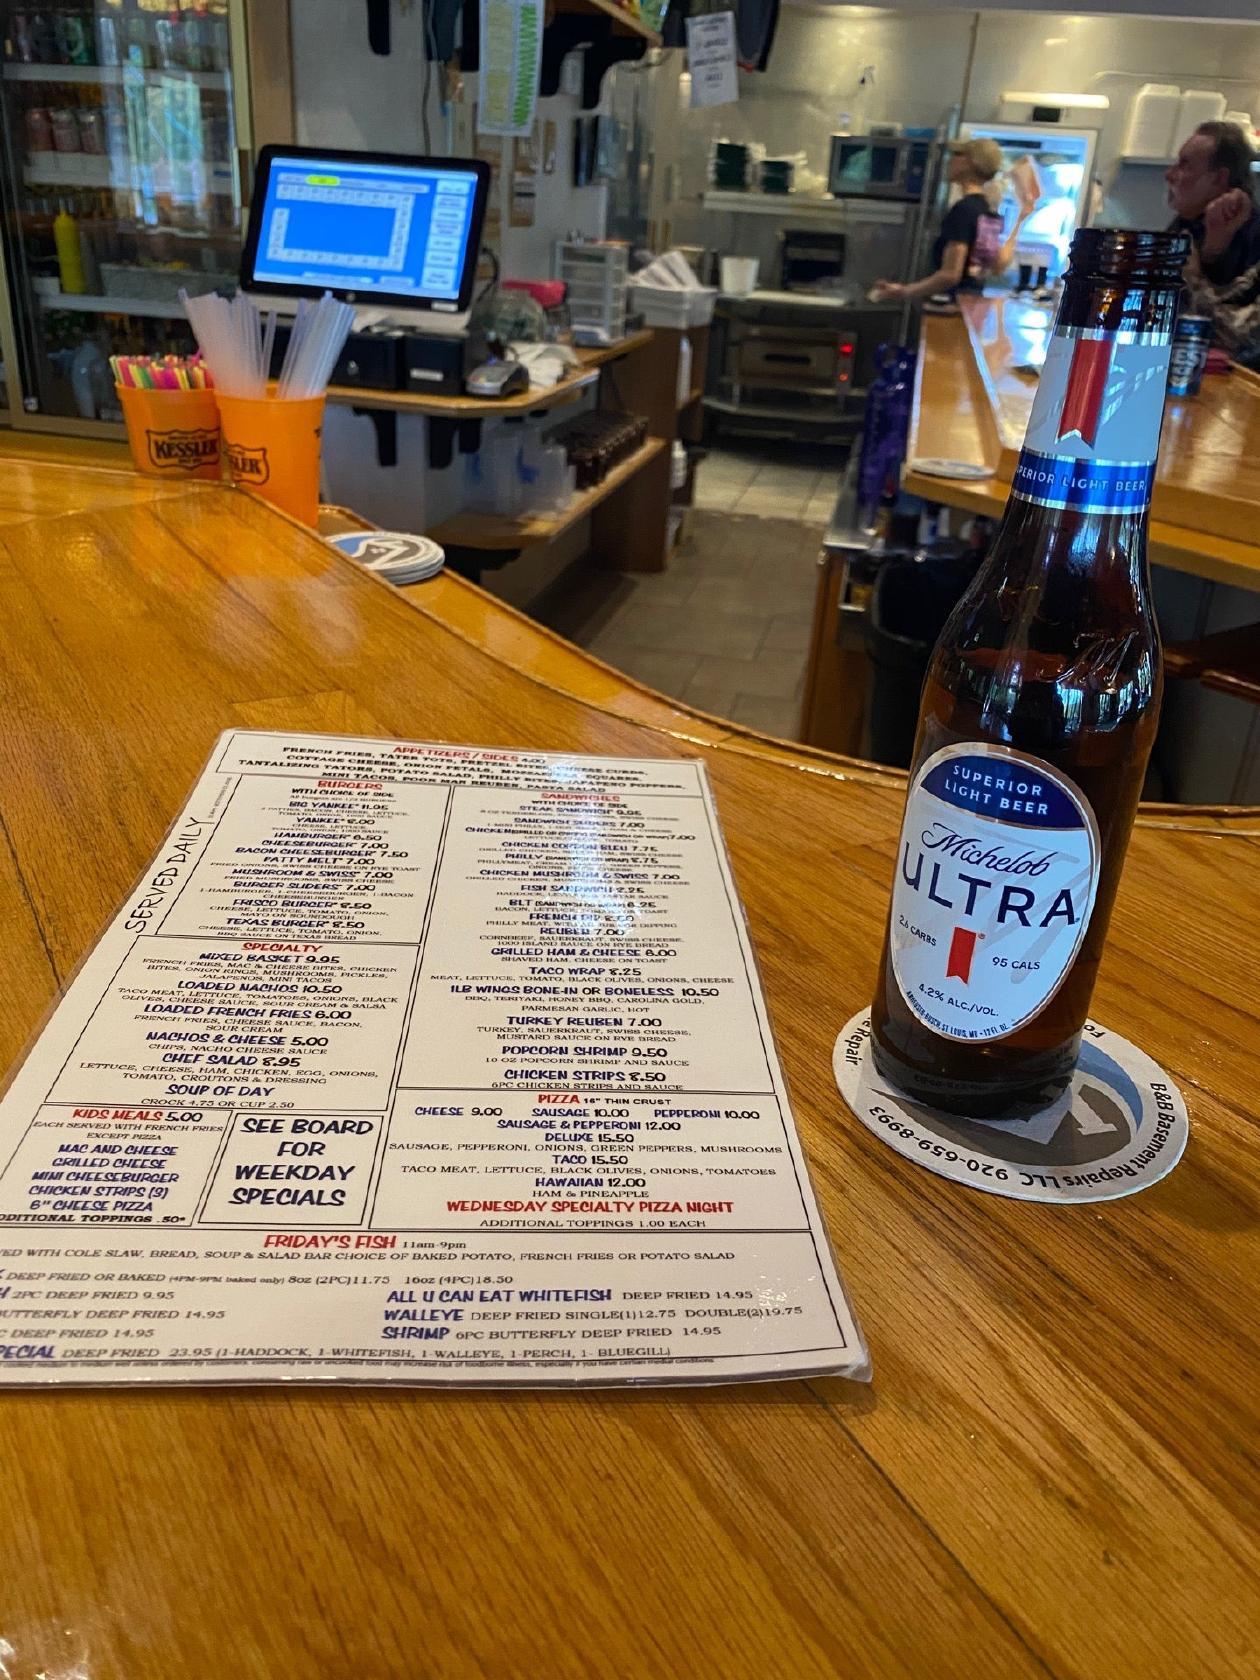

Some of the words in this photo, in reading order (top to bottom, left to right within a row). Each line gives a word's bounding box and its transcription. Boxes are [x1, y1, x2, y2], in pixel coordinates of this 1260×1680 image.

[1063, 477, 1108, 490] LIGHT
[1115, 480, 1145, 491] BEER
[953, 764, 1043, 797] SUPERIOR
[945, 779, 992, 806] LIGHT
[1000, 797, 1049, 816] BEER
[921, 822, 1058, 877] Michelob
[125, 867, 178, 934] SERVED
[166, 816, 215, 864] DAILY
[903, 841, 1078, 928] ULTRA
[226, 918, 269, 926] TEXAS
[910, 926, 937, 947] CARBS
[243, 941, 323, 953] SPECIALTY
[547, 948, 576, 956] HAM
[199, 953, 243, 961] MIXED
[246, 954, 304, 963] BASKET
[304, 956, 340, 964] 9.95
[992, 956, 1008, 968] 95
[1011, 960, 1041, 970] CALS
[528, 967, 564, 975] TACO
[568, 967, 605, 975] WRAP
[608, 968, 641, 976] 8.25
[178, 981, 235, 991] LOADED
[237, 983, 299, 993] NACHOS
[302, 985, 343, 994] 10.50
[476, 986, 520, 994] WINGS
[523, 986, 578, 995] BONE-IN
[582, 987, 601, 995] OR
[605, 987, 675, 996] BONELESS
[681, 988, 719, 996] 10.50
[918, 983, 944, 1002] 4.2%
[947, 997, 999, 1017] ALC./VOL.
[144, 1004, 204, 1014] LOADED
[207, 1006, 267, 1017] FRENCH
[269, 1009, 312, 1019] FRIES
[314, 1010, 352, 1019] 6.00
[506, 1016, 564, 1025] TURKEY
[567, 1017, 623, 1026] REUBEN
[627, 1018, 662, 1027] 7.00
[145, 1032, 210, 1042] NACHOS
[212, 1034, 225, 1043] &
[227, 1034, 287, 1045] CHEESE
[290, 1037, 329, 1046] 5.00
[502, 1046, 568, 1055] POPCORN
[573, 1047, 627, 1056] SHRIMP
[631, 1048, 668, 1058] 9.50
[845, 1028, 871, 1066] Repair
[162, 1053, 205, 1064] CHEF
[205, 1055, 258, 1066] SALAD
[262, 1057, 302, 1067] 8.95
[504, 1069, 567, 1080] CHICKEN
[572, 1070, 626, 1081] STRIPS
[628, 1072, 666, 1082] 8.50
[165, 1084, 210, 1095] SOUP
[213, 1086, 236, 1096] OF
[238, 1086, 276, 1096] DAY
[1150, 1082, 1174, 1111] B&B
[141, 1098, 185, 1106] CROCK
[538, 1094, 581, 1104] PIZZA
[633, 1098, 672, 1106] CRUST
[72, 1109, 110, 1119] KIDS
[111, 1110, 164, 1121] MEALS
[164, 1112, 203, 1122] 5.00
[415, 1107, 464, 1116] CHEESE
[471, 1107, 503, 1116] 9.00
[531, 1108, 590, 1117] SAUSAGE
[594, 1109, 629, 1117] 10.00
[654, 1109, 721, 1118] PEPPERONI
[724, 1110, 760, 1119] 10.00
[240, 1118, 286, 1133] SEE
[291, 1119, 374, 1135] BOARD
[497, 1119, 557, 1129] SAUSAGE
[560, 1121, 570, 1129] &
[573, 1120, 641, 1130] PEPPERONI
[645, 1121, 681, 1130] 12.00
[545, 1133, 594, 1142] DELUXE
[598, 1133, 634, 1143] 15.50
[869, 1106, 1009, 1182] 920-659-8993
[1129, 1112, 1176, 1172] Basement
[58, 1144, 87, 1153] MAC
[91, 1145, 122, 1154] AND
[124, 1145, 179, 1156] CHEESE
[277, 1141, 326, 1157] FOR
[52, 1158, 110, 1167] GRILLED
[112, 1158, 168, 1169] CHEESE
[552, 1155, 587, 1164] TACO
[591, 1155, 628, 1165] 15.50
[31, 1171, 65, 1180] MINI
[66, 1172, 179, 1183] CHEESEBURGER
[235, 1165, 356, 1181] WEEKDAY
[1064, 1164, 1138, 1189] Repairs
[535, 1177, 603, 1187] HAWAIIAN
[607, 1178, 646, 1187] 12.00
[1018, 1172, 1061, 1189] LLC
[28, 1185, 92, 1196] CHICKEN
[93, 1186, 146, 1197] STRIPS
[148, 1187, 169, 1200] (3)
[228, 1187, 346, 1206] SPECIALS
[52, 1200, 109, 1211] CHEESE
[112, 1201, 152, 1212] PIZZA
[447, 1200, 548, 1212] WEDNESDAY
[550, 1201, 635, 1213] SPECIALTY
[639, 1201, 683, 1213] PIZZA
[686, 1201, 734, 1213] NIGHT
[0, 1214, 76, 1222] DDITIONAL
[264, 1235, 351, 1249] FRIDAY'S
[355, 1235, 397, 1249] FISH
[403, 1240, 466, 1250] 11am-9pm
[387, 1291, 417, 1303] ALL
[423, 1291, 435, 1302] U
[438, 1290, 474, 1303] CAN
[479, 1290, 515, 1302] EAT
[519, 1289, 612, 1302] WHITEFISH
[716, 1291, 753, 1299] 14.95
[384, 1309, 464, 1321] WALLEYE
[471, 1312, 511, 1320] DEEP
[515, 1312, 561, 1320] FRIED
[381, 1326, 450, 1340] SHRIMP
[456, 1331, 484, 1340] 6PC
[489, 1330, 576, 1339] BUTTERFLY
[582, 1329, 622, 1338] DEEP
[627, 1328, 672, 1337] FRIED
[683, 1327, 721, 1336] 14.95
